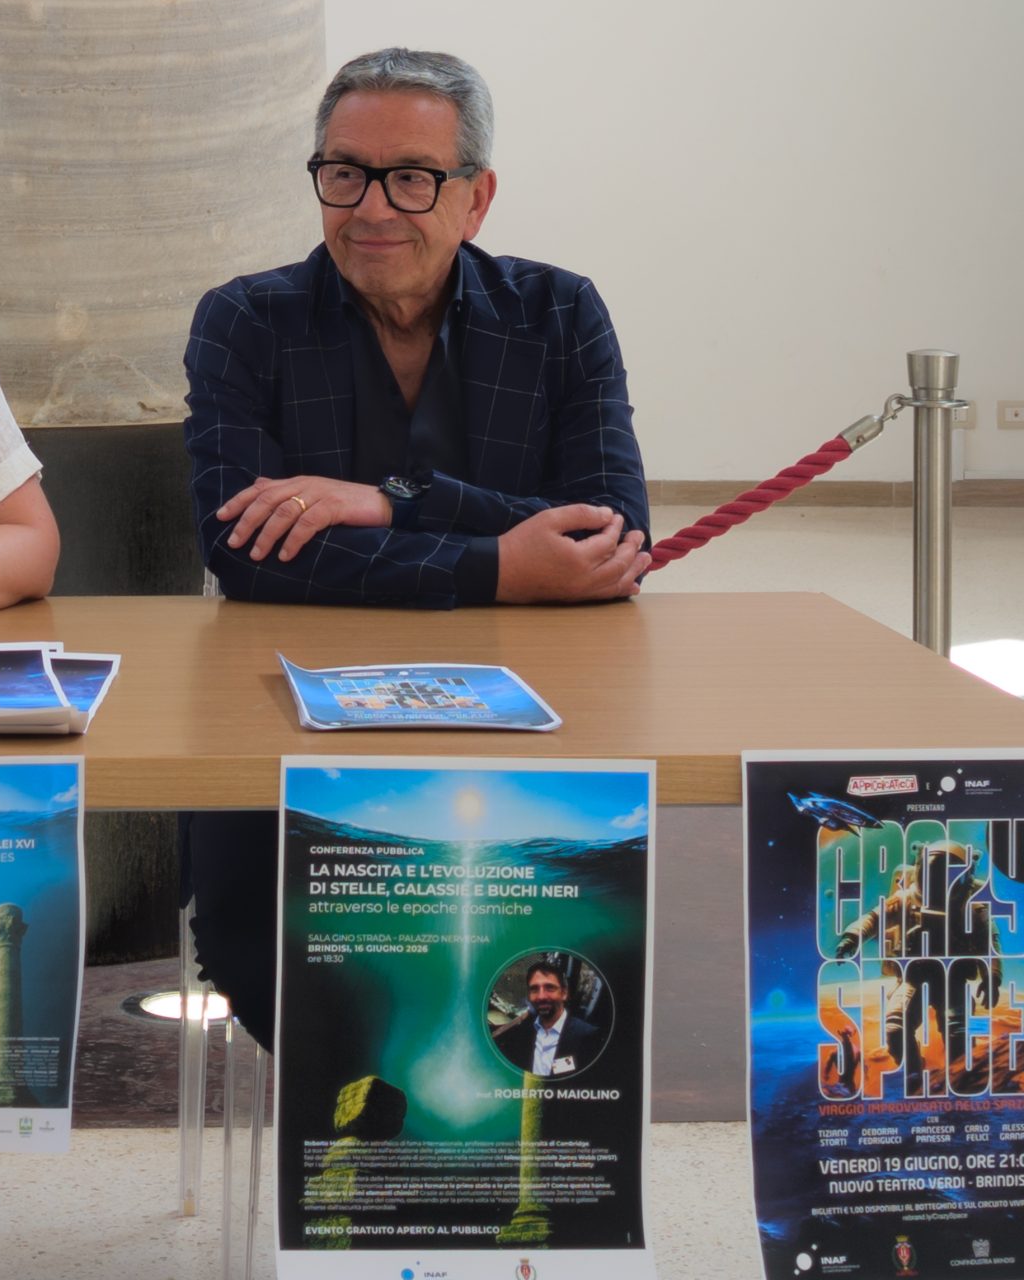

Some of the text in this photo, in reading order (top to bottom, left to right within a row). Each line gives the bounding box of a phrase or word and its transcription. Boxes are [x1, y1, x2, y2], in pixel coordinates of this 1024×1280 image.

[907, 804, 945, 812] PRESENTANO
[15, 838, 35, 849] XVI
[310, 846, 425, 855] CONFERENZA PUBBLICA
[310, 864, 535, 879] LA NASCITA E L'EVOLUZIONE
[309, 882, 579, 898] DI STELLE, GALASSIE E BUCHI NERI
[816, 818, 1024, 961] CRAZY
[309, 900, 533, 916] attraverso le epoche cosmiche
[308, 934, 330, 942] SALA
[332, 934, 355, 942] GINO
[357, 934, 392, 942] STRADA
[398, 935, 439, 943] PALAZZO
[308, 945, 429, 953] BRINDISI, 16 GIUGNO 2026
[323, 955, 344, 963] 18:30
[817, 956, 1024, 1101] SPACE
[494, 1088, 620, 1100] ROBERTO MAIOLINO
[819, 1101, 990, 1116] VIAGGIO IMPROVVISATO NELLO
[862, 1127, 898, 1136] DEBORAH
[911, 1125, 955, 1134] FRANCESCA
[964, 1124, 990, 1132] CARLO
[818, 1129, 848, 1137] TIZIANO
[966, 1133, 989, 1141] FELICI
[820, 1138, 847, 1147] STORTI
[858, 1136, 902, 1145] FEDRIGUCCI
[916, 1134, 951, 1143] PANESSA
[819, 1154, 995, 1175] VENERDÌ 19 GIUGNO, ORE
[829, 1180, 874, 1194] NUOVO
[877, 1177, 926, 1192] TEATRO
[928, 1176, 966, 1190] VERDI
[811, 1200, 1008, 1216] BIGLIETTI € 1,00 DISPONIBILI AL BOTTEGHINO E SUL CIRCUITO
[305, 1226, 500, 1235] EVENTO GRATUITO APERTO AL PUBBLICO
[820, 1256, 847, 1264] INAF
